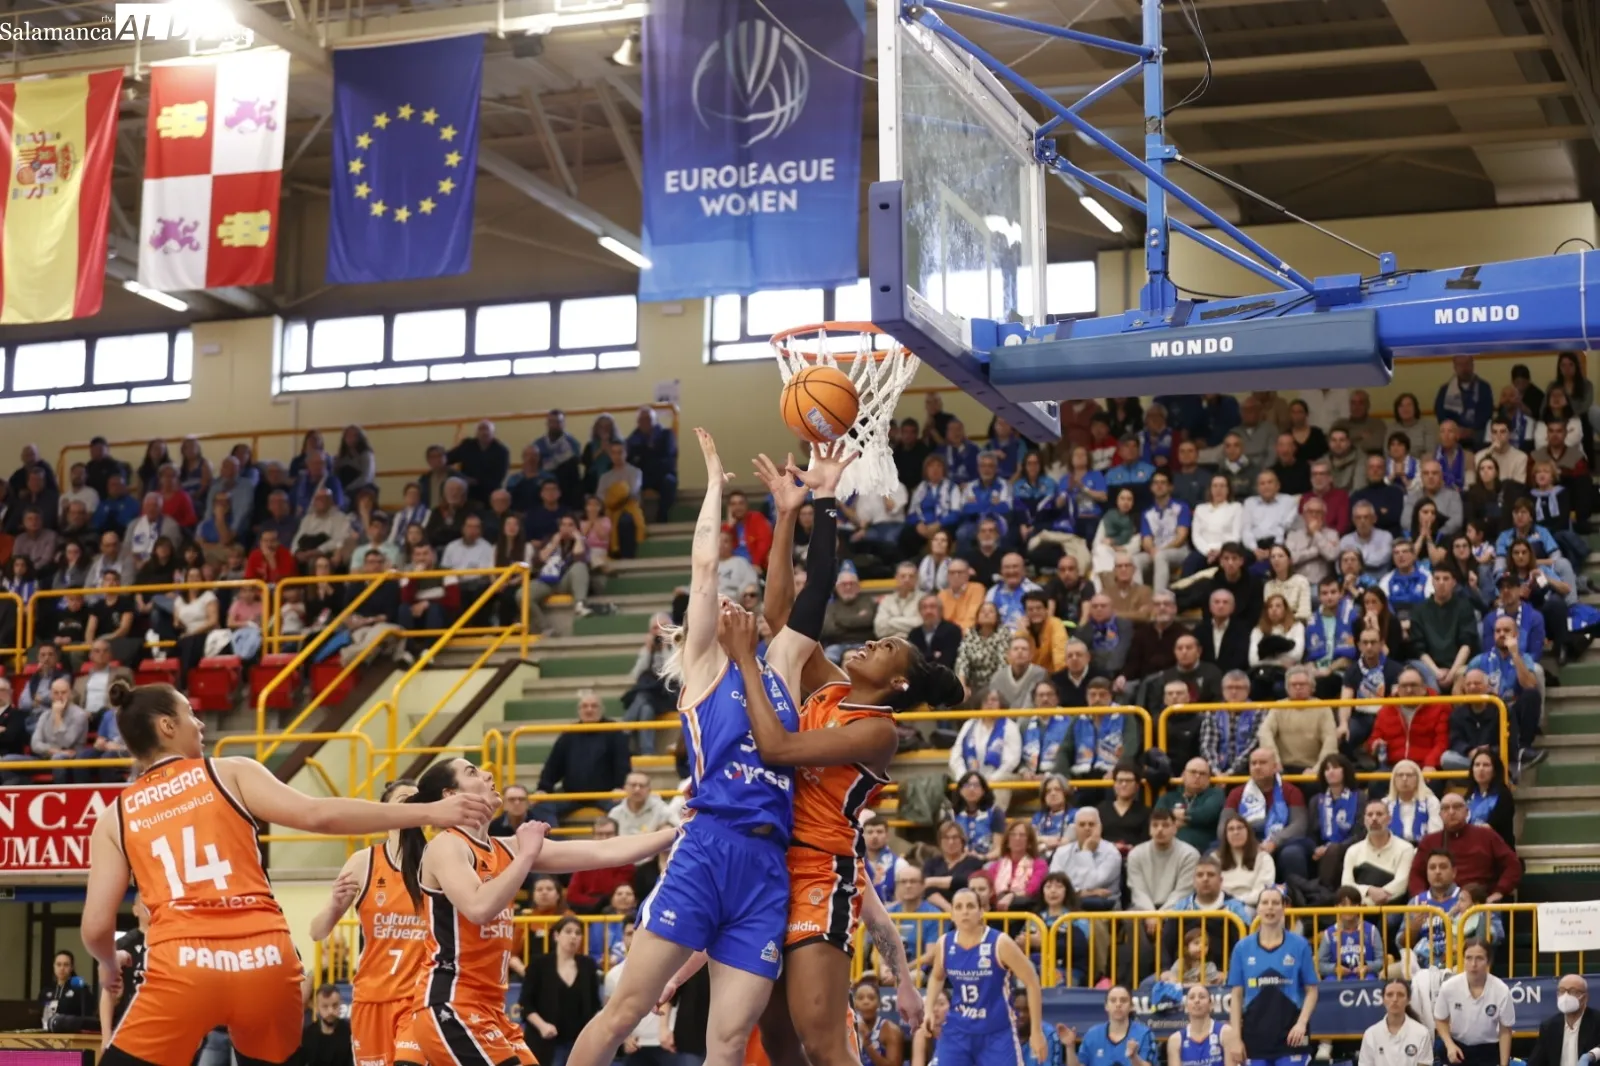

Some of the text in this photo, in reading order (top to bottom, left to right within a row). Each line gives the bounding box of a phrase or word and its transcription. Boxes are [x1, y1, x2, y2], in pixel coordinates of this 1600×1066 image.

[665, 157, 835, 194] EUROLEAGUE
[700, 189, 798, 217] WOMEN
[1434, 304, 1520, 325] MONDO
[1150, 336, 1234, 358] MONDO
[124, 766, 207, 814] CARRERA
[151, 825, 232, 900] 14
[178, 944, 283, 973] PAMESA
[388, 949, 403, 975] 7
[961, 984, 979, 1004] 13
